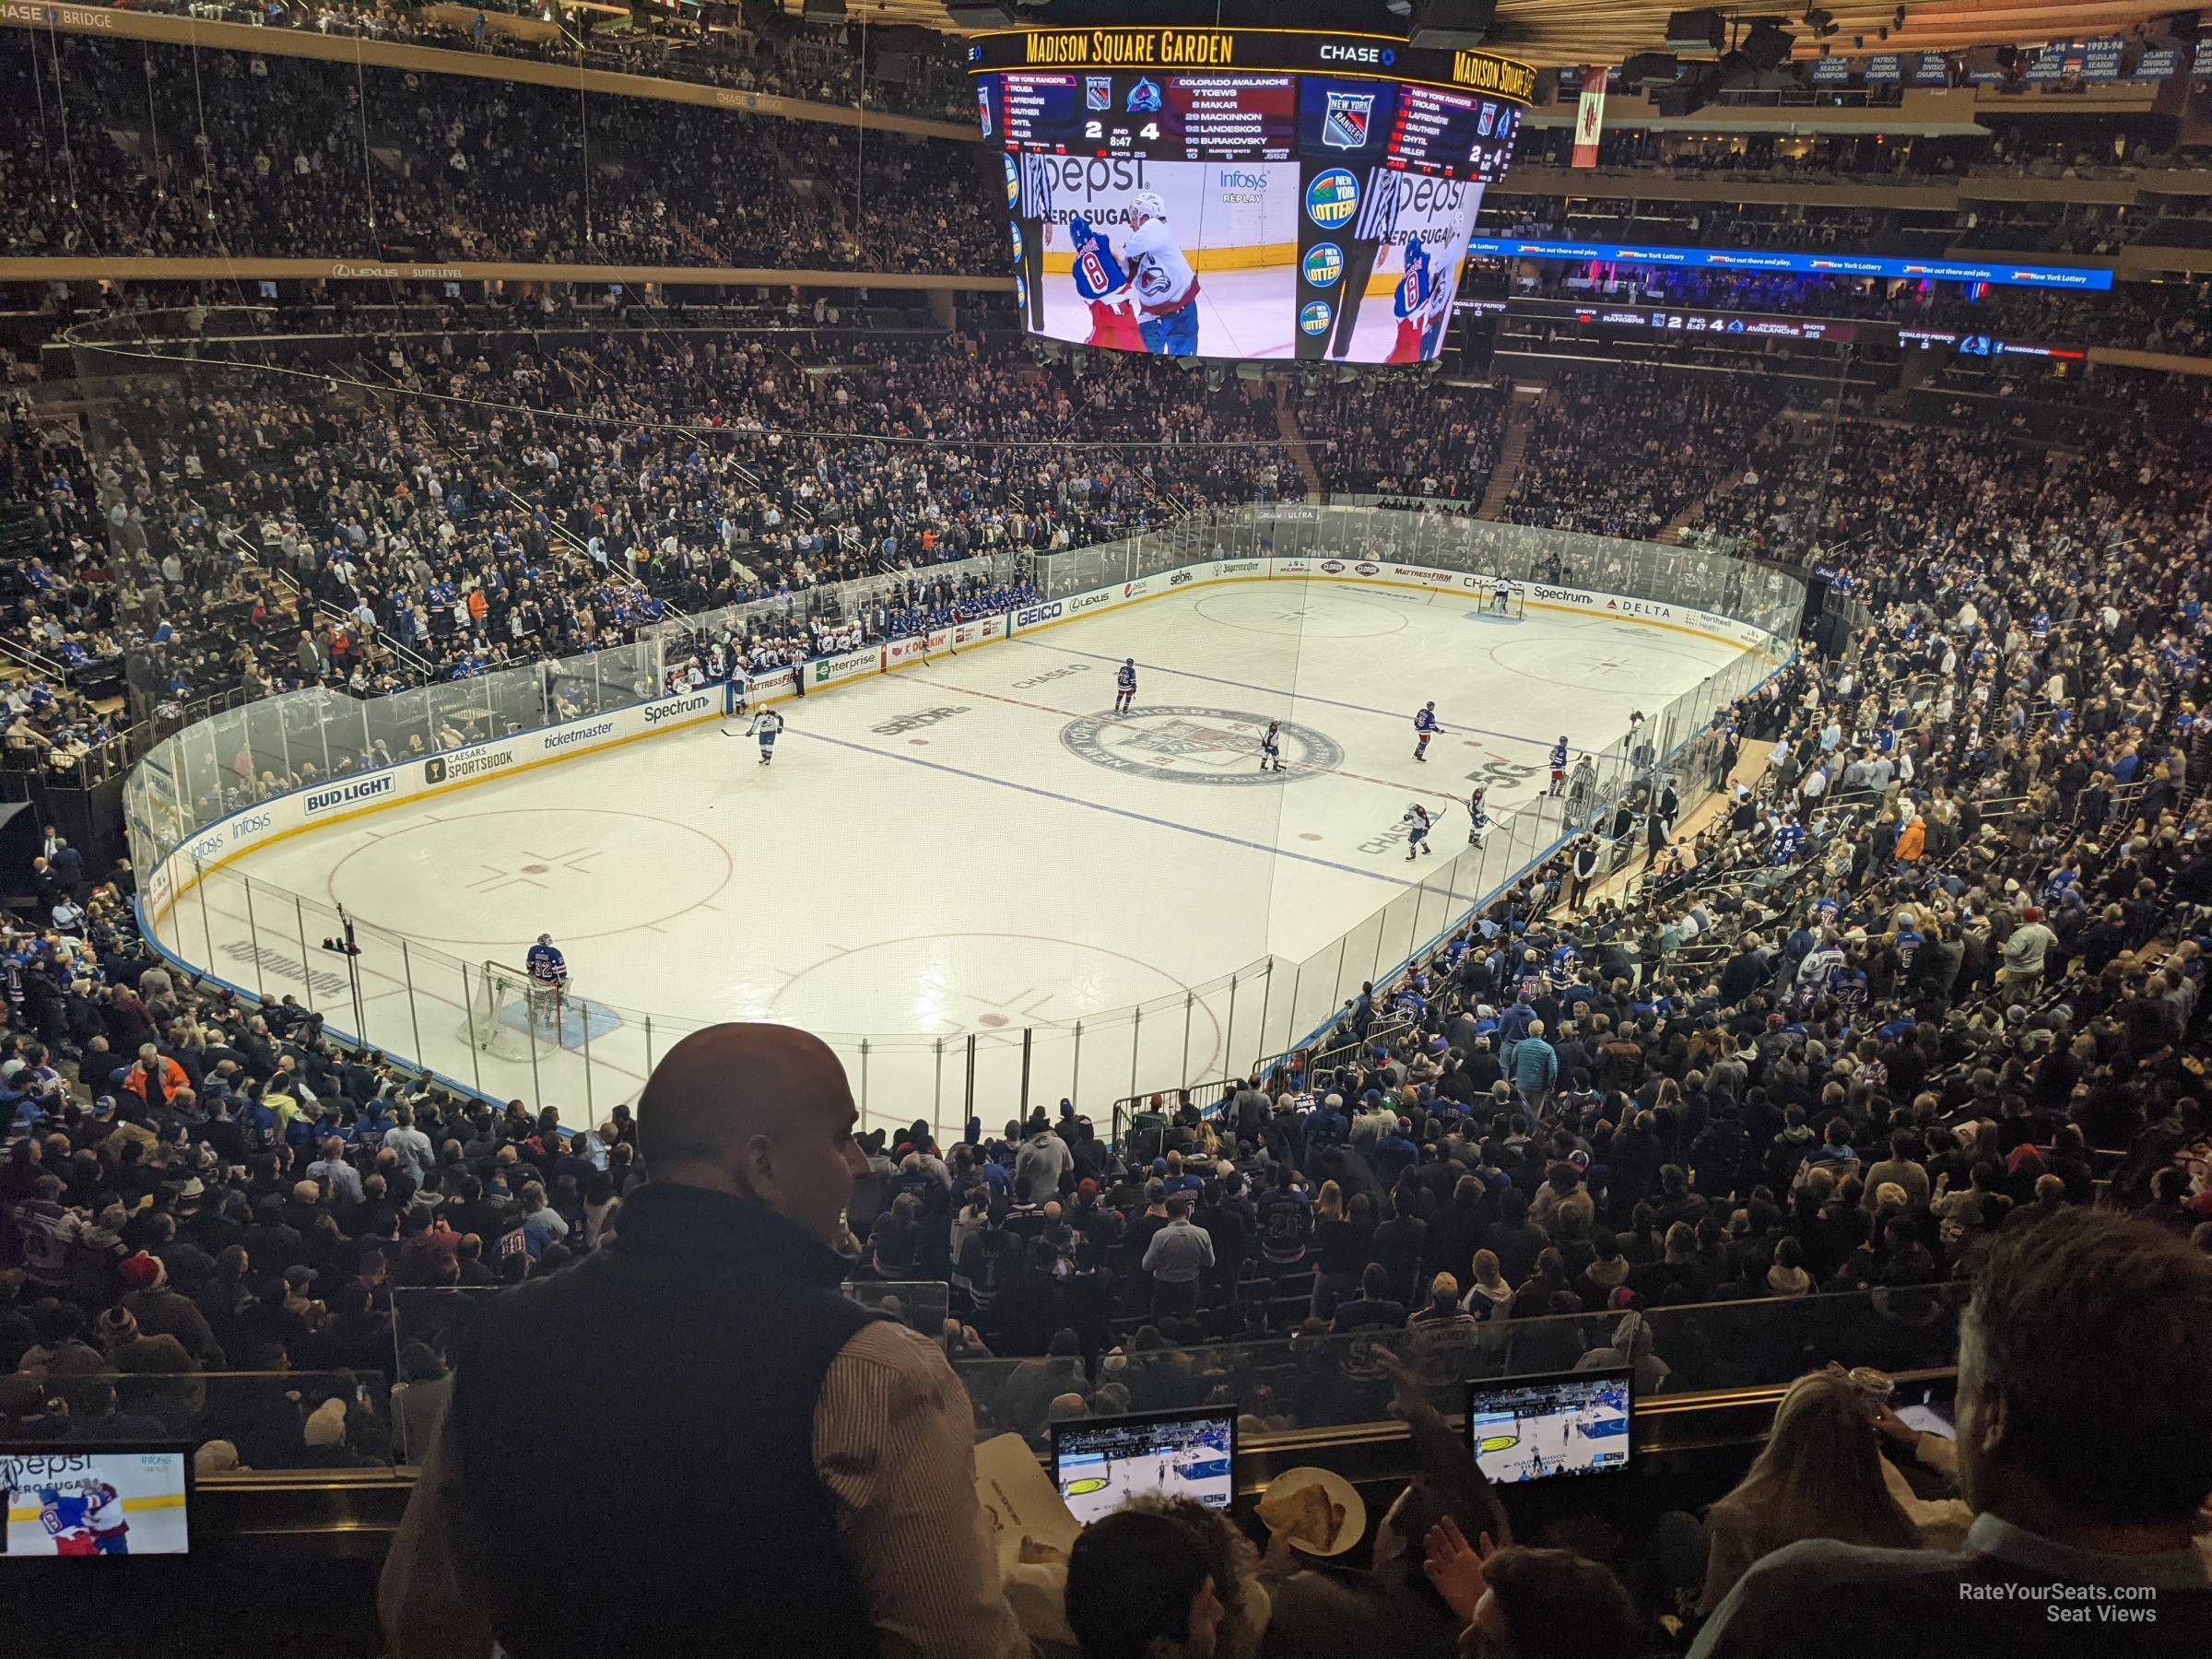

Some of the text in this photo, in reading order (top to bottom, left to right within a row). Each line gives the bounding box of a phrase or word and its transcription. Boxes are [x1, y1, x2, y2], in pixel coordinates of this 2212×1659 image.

[0, 5, 112, 28] HASE BRIDGE
[1026, 30, 1233, 64] MADISON SQUARE GARDEN
[1320, 45, 1379, 63] CHASE
[1453, 51, 1500, 89] MADISON
[1010, 85, 1033, 93] TROUBA
[1231, 78, 1289, 87] AVALANCHE
[716, 92, 747, 105] CHASE
[1330, 99, 1370, 111] NEW YORK
[1412, 89, 1472, 107] NEW YORK RANGERS
[1412, 100, 1440, 111] TROUBA
[1010, 108, 1040, 116] GAUTHIER
[1011, 119, 1031, 127] CHYTIL
[1085, 121, 1102, 138] 2
[1334, 112, 1365, 144] RANGERS
[1406, 124, 1440, 135] GAUTHIER
[1011, 130, 1031, 138] MILLER
[1139, 123, 1159, 140] 4
[1110, 137, 1132, 147] 8:47
[1403, 135, 1428, 146] CHYTIL
[1399, 147, 1425, 157] MILLER
[1469, 146, 1481, 162] 2
[1493, 149, 1502, 165] 4
[1220, 170, 1267, 191] Infosys
[1336, 175, 1352, 186] NEW
[1223, 194, 1262, 203] REPLAY
[1336, 185, 1355, 201] YORK
[1312, 199, 1357, 221] LOTTERY
[1324, 248, 1337, 256] NEW
[1477, 242, 1499, 252] Lottery
[1557, 247, 1572, 255] there
[1325, 256, 1340, 267] YORK
[1662, 253, 1685, 261] Lottery
[1747, 257, 1762, 265] there
[351, 268, 463, 277] LEXUS SUITE LEVEL
[1083, 253, 1109, 294] 8
[1307, 265, 1341, 282] LOTTERY
[1858, 263, 1881, 272] Lottery
[1945, 267, 1962, 276] there
[2062, 275, 2087, 284] Lottery
[1405, 272, 1420, 311] 8
[1603, 316, 1645, 324] RANGERS
[1667, 317, 1682, 329] 2
[1686, 323, 1706, 331] 8:47
[1709, 319, 1724, 331] 4
[1747, 325, 1799, 335] AVALANCHE
[1324, 563, 1343, 571] CLOROX
[1357, 565, 1377, 573] CLOROX
[1080, 593, 1110, 606] LEXUS
[1534, 586, 1590, 604] Spectrum
[1018, 602, 1063, 627] GEICO
[1622, 600, 1671, 618] DELTA
[1700, 613, 1732, 628] Northwell
[912, 635, 947, 653] DUKIN'
[819, 654, 876, 676] enterprise
[1012, 668, 1077, 689] CHASE
[644, 695, 706, 724] Spectrum
[544, 721, 614, 749] ticketmaster
[1071, 721, 1098, 747] YORK
[447, 747, 487, 764] CAESARS
[1076, 747, 1129, 768] NEW
[449, 750, 514, 779] SPORTSBOOK
[307, 775, 393, 811] BUD LIGHT
[231, 812, 271, 840] Infosys
[1357, 820, 1414, 854] CHAS
[1901, 948, 1913, 969] 5
[535, 960, 553, 977] 32
[47, 1480, 84, 1491] SUGA
